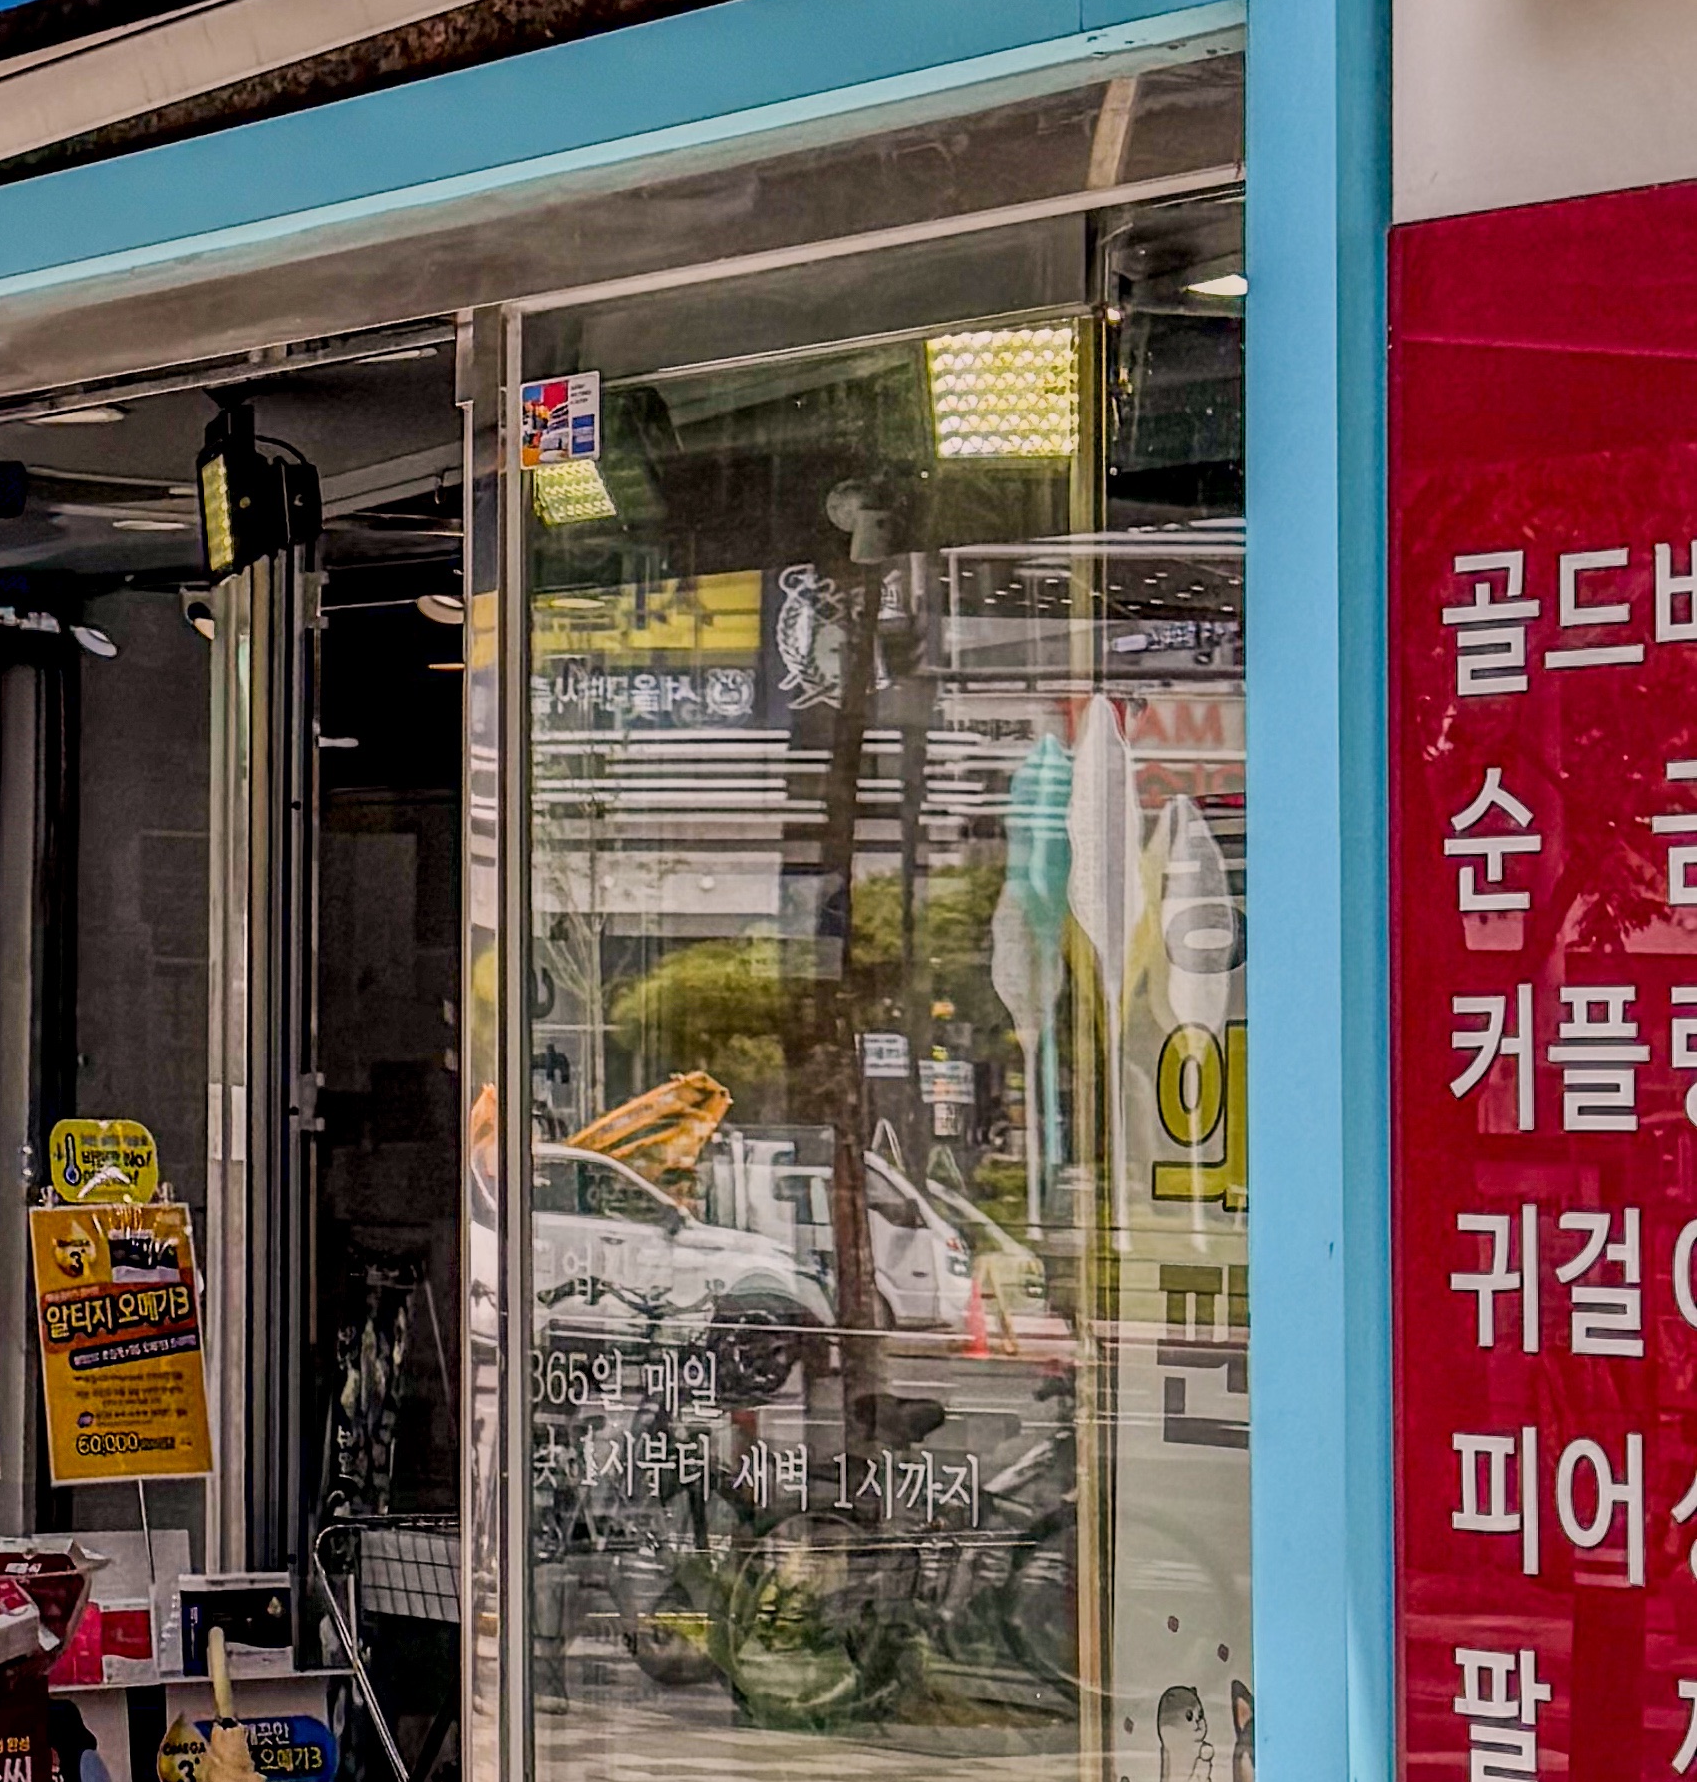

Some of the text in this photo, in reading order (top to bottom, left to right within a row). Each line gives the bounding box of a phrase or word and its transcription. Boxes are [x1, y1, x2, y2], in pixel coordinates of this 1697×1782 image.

[46, 1285, 190, 1339] 알티지 오메가3
[643, 1348, 725, 1418] 매일
[77, 1433, 139, 1454] 60,000
[732, 1439, 808, 1512] 새벽
[833, 1449, 979, 1529] 1시까지
[260, 1746, 323, 1772] 오메가3
